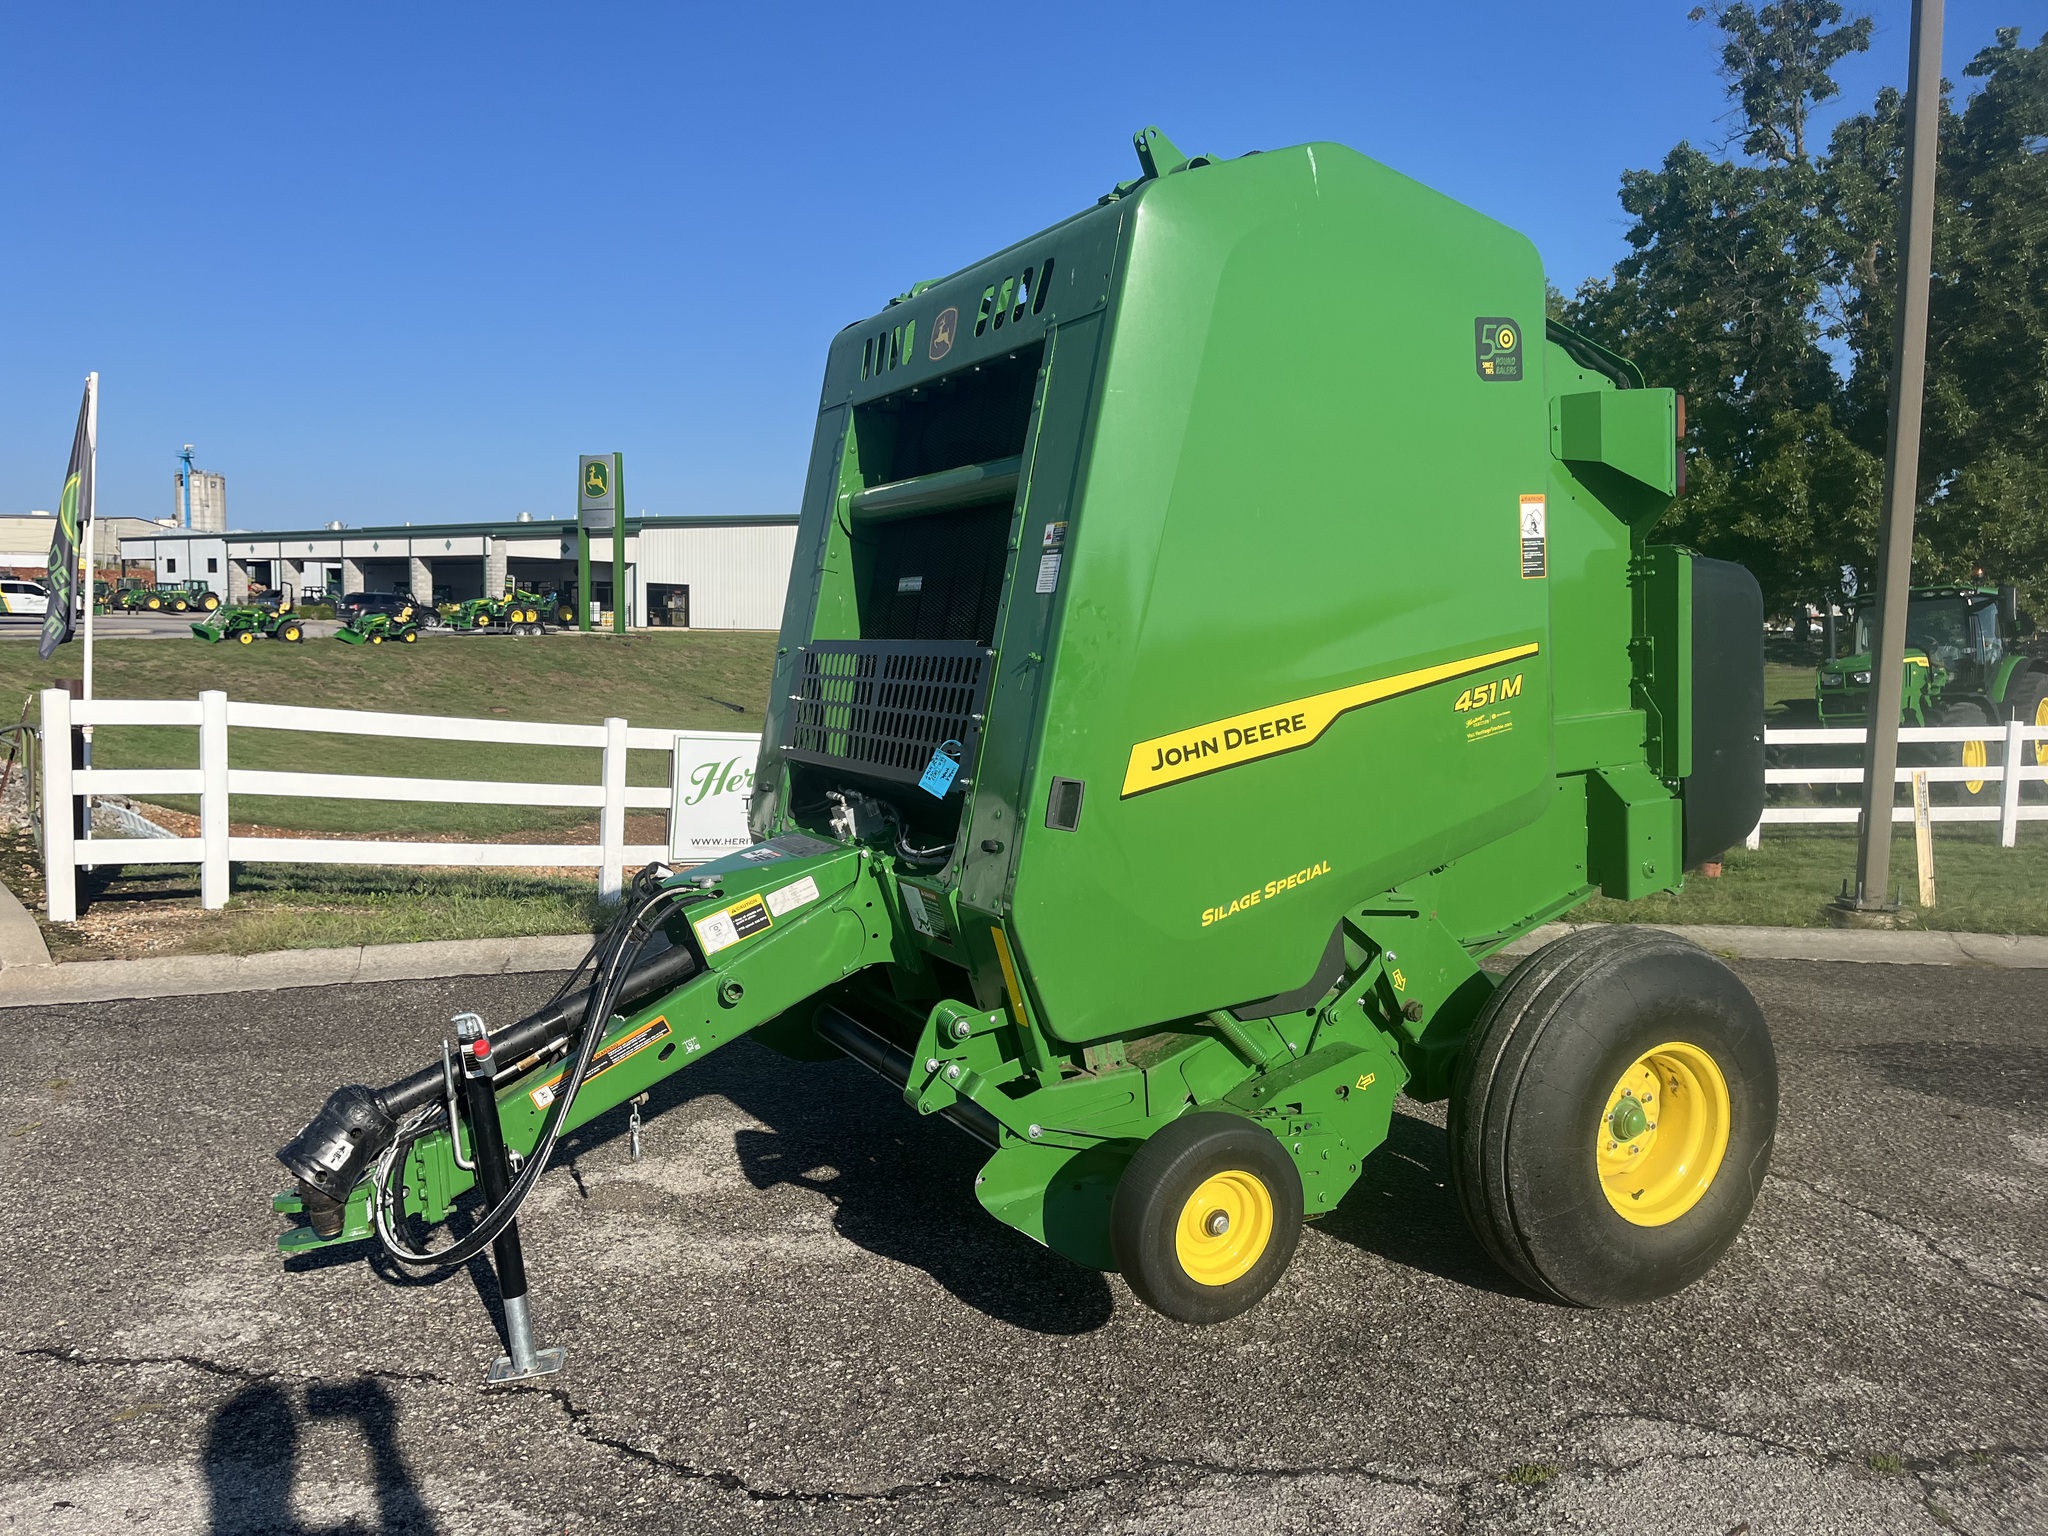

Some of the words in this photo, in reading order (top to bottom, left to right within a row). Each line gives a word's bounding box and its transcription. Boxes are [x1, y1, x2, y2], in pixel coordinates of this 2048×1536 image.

[1480, 323, 1518, 360] 50
[1453, 680, 1498, 712] 451
[1500, 673, 1523, 701] M
[1151, 735, 1219, 772] JOHN
[1225, 713, 1306, 751] DEERE
[736, 898, 758, 911] CAUTION
[1201, 889, 1261, 928] SILAGE
[1264, 860, 1332, 899] SPECIAL
[595, 1042, 619, 1058] WARNING
